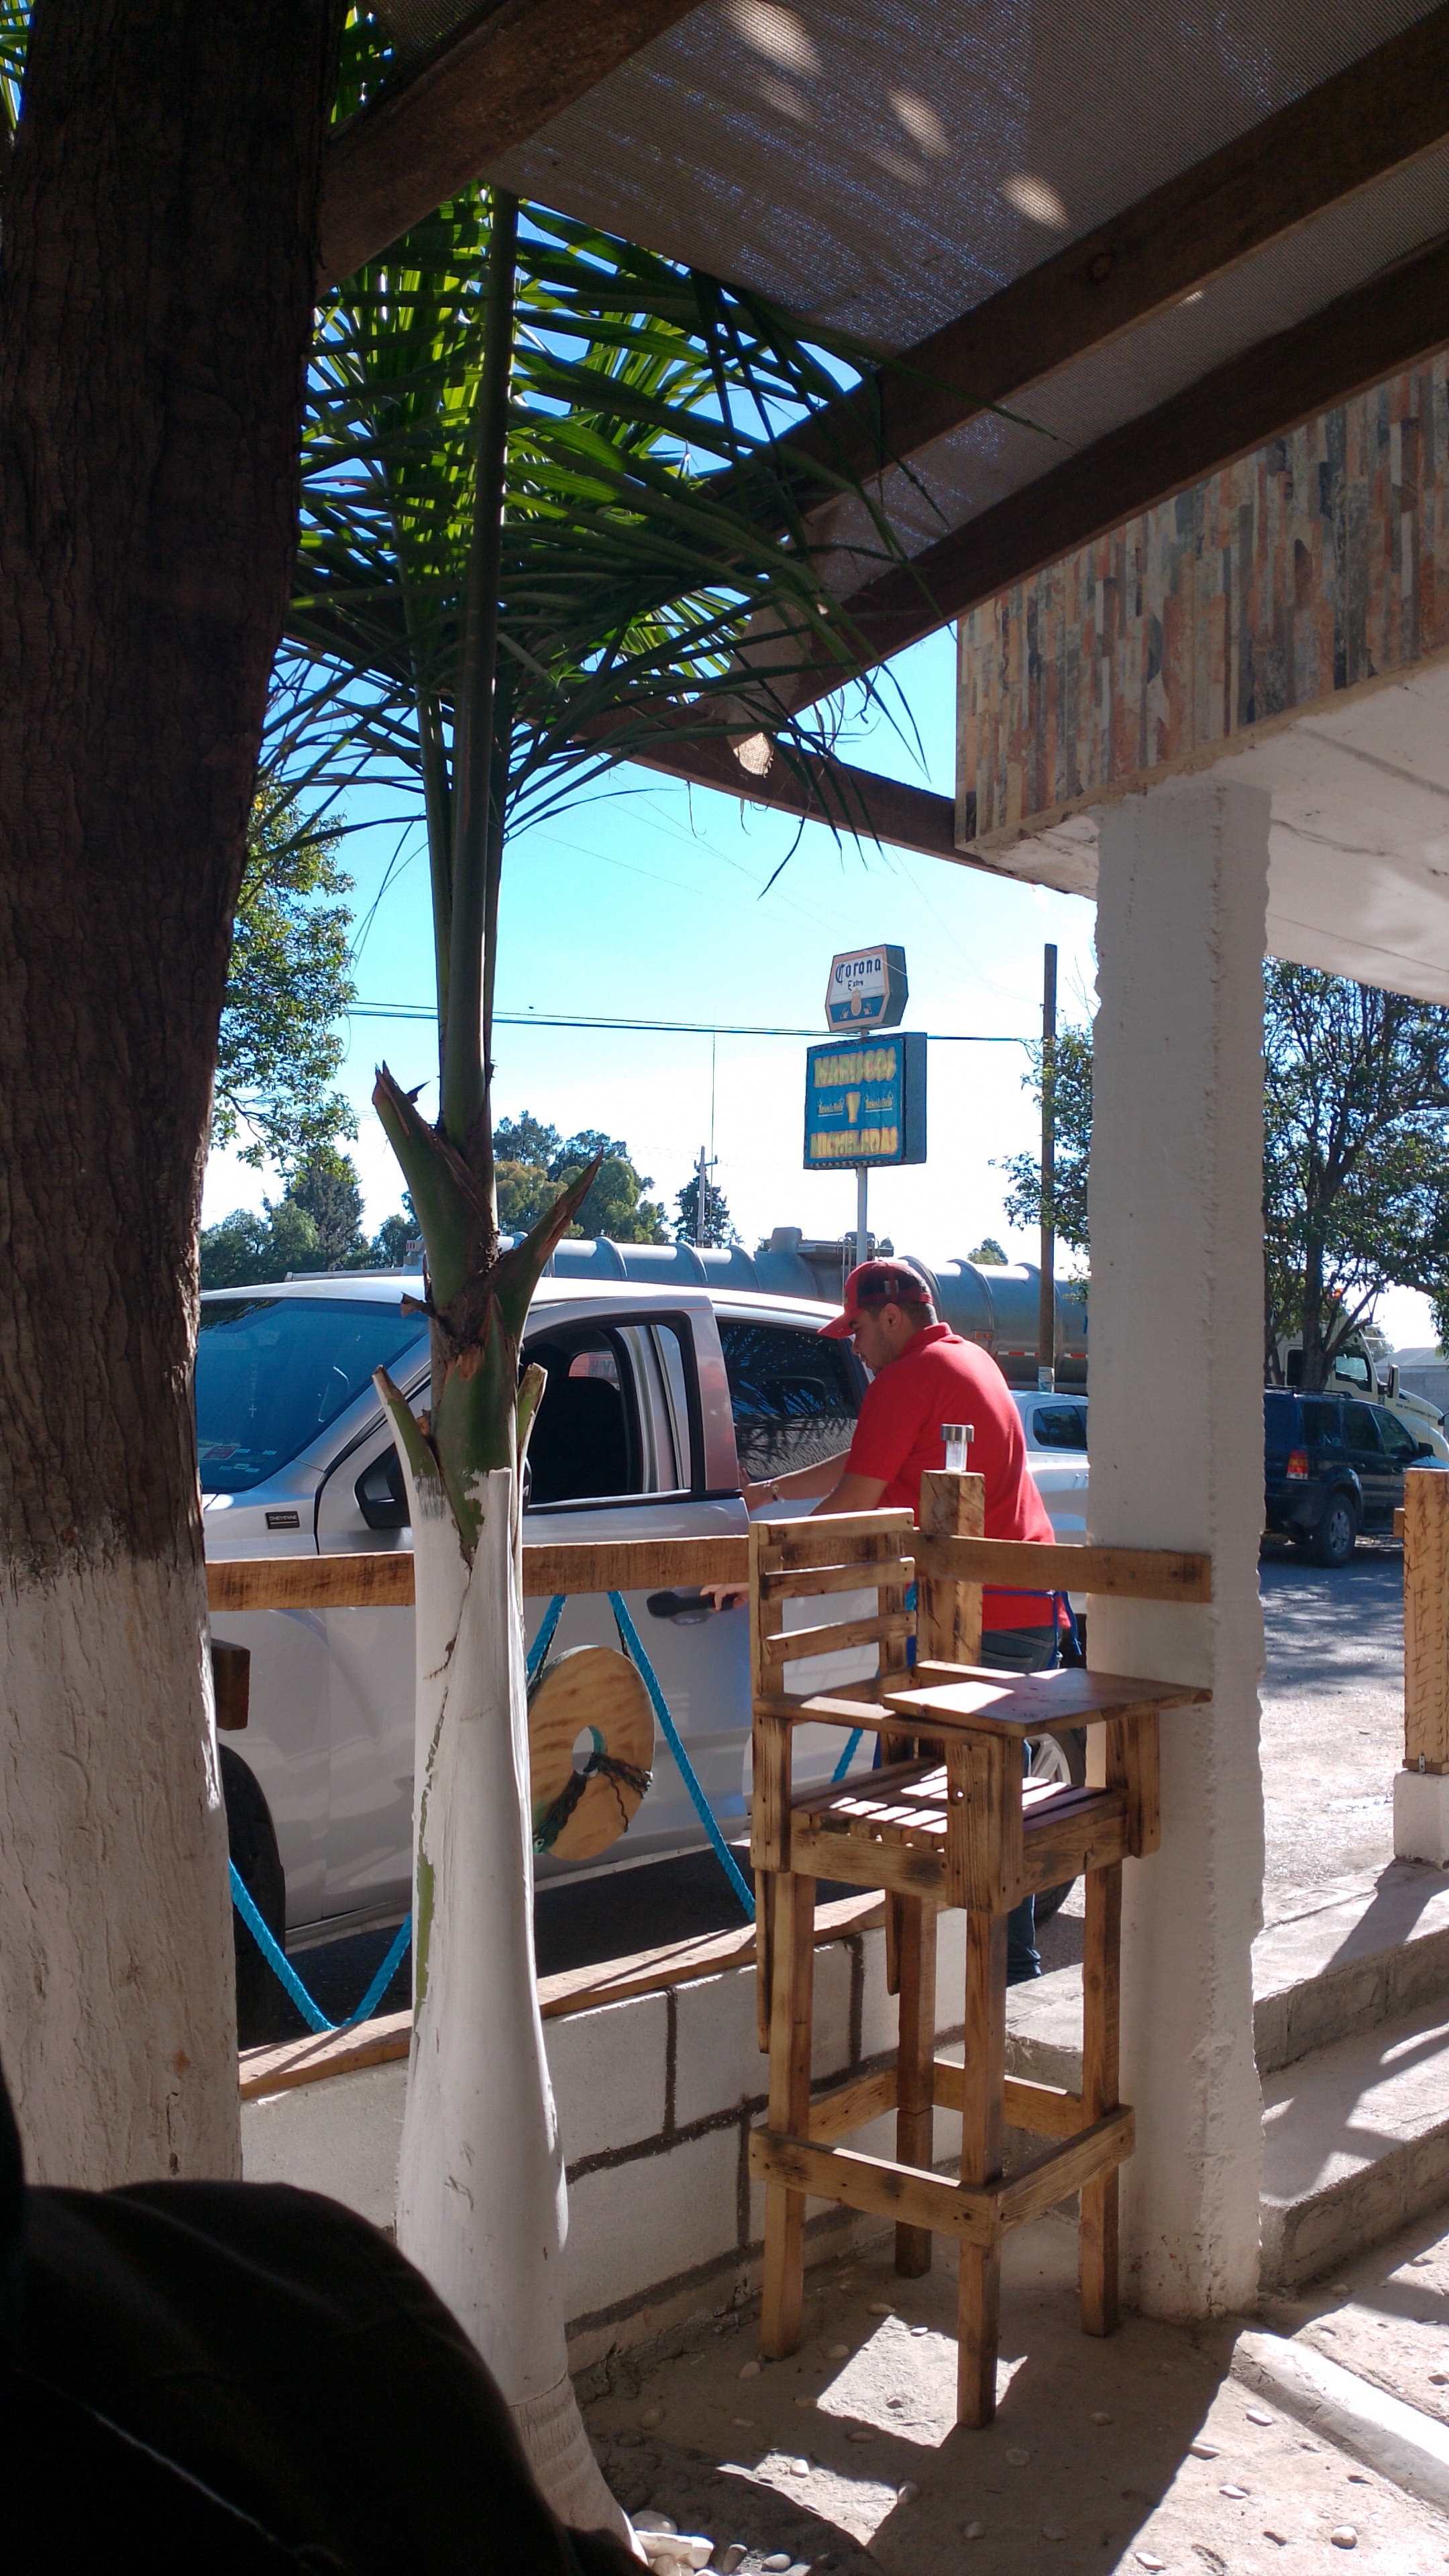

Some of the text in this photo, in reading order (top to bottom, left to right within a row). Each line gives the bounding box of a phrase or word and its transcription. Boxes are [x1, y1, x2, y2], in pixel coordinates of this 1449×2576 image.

[836, 957, 881, 985] Corona
[847, 979, 864, 991] Extra
[814, 1047, 896, 1087] MARISCOS
[811, 1127, 898, 1159] MICHELADAS
